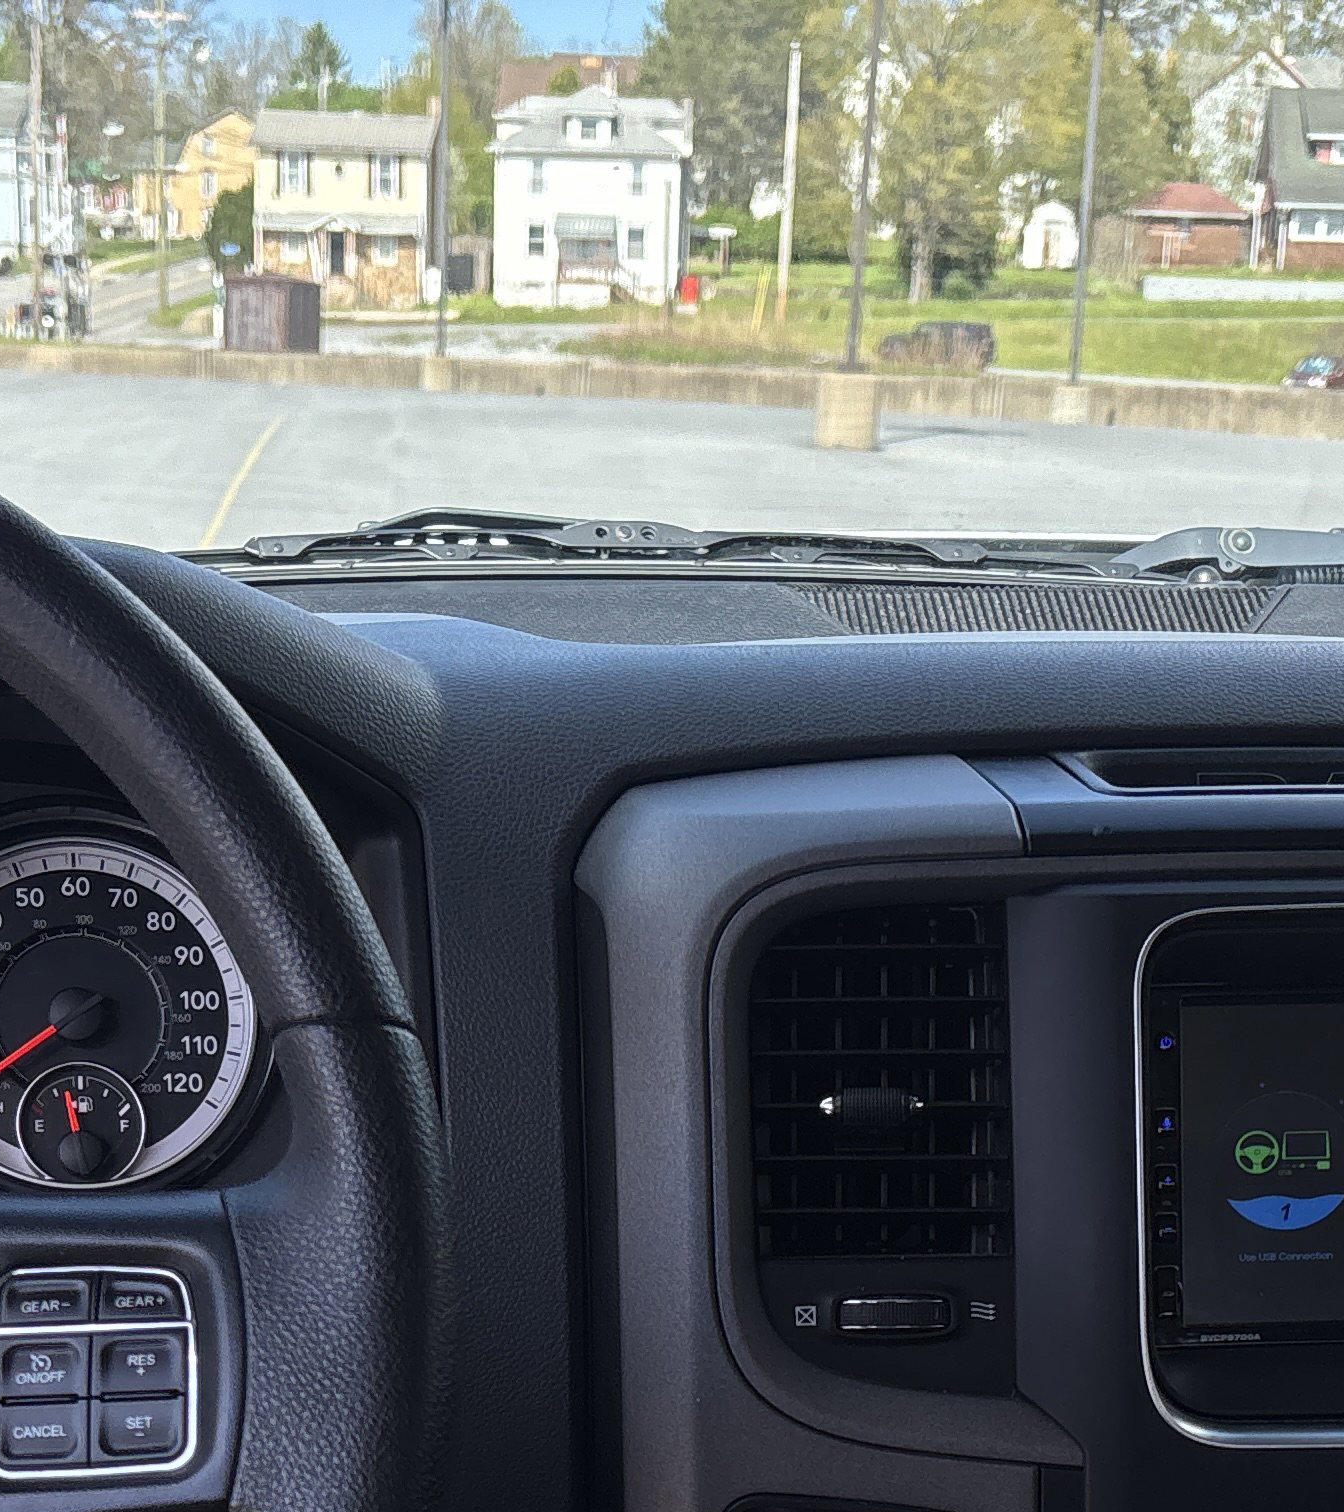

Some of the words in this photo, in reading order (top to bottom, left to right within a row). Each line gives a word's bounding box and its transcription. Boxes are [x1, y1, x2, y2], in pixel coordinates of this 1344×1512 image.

[60, 876, 91, 897] 60
[15, 887, 45, 908] 50
[107, 888, 138, 909] 70
[146, 911, 176, 932] 80
[173, 945, 204, 966] 90
[179, 990, 220, 1011] 100
[181, 1035, 218, 1056] 110
[162, 1072, 204, 1094] 120
[34, 1119, 44, 1133] E
[120, 1119, 130, 1133] F
[1281, 1202, 1291, 1221] 1
[1258, 1252, 1276, 1261] USB
[1278, 1251, 1334, 1261] Connection
[126, 1354, 156, 1367] RES
[15, 1371, 67, 1385] ON/OFF
[13, 1425, 67, 1440] CANCEL
[125, 1416, 153, 1430] SET
